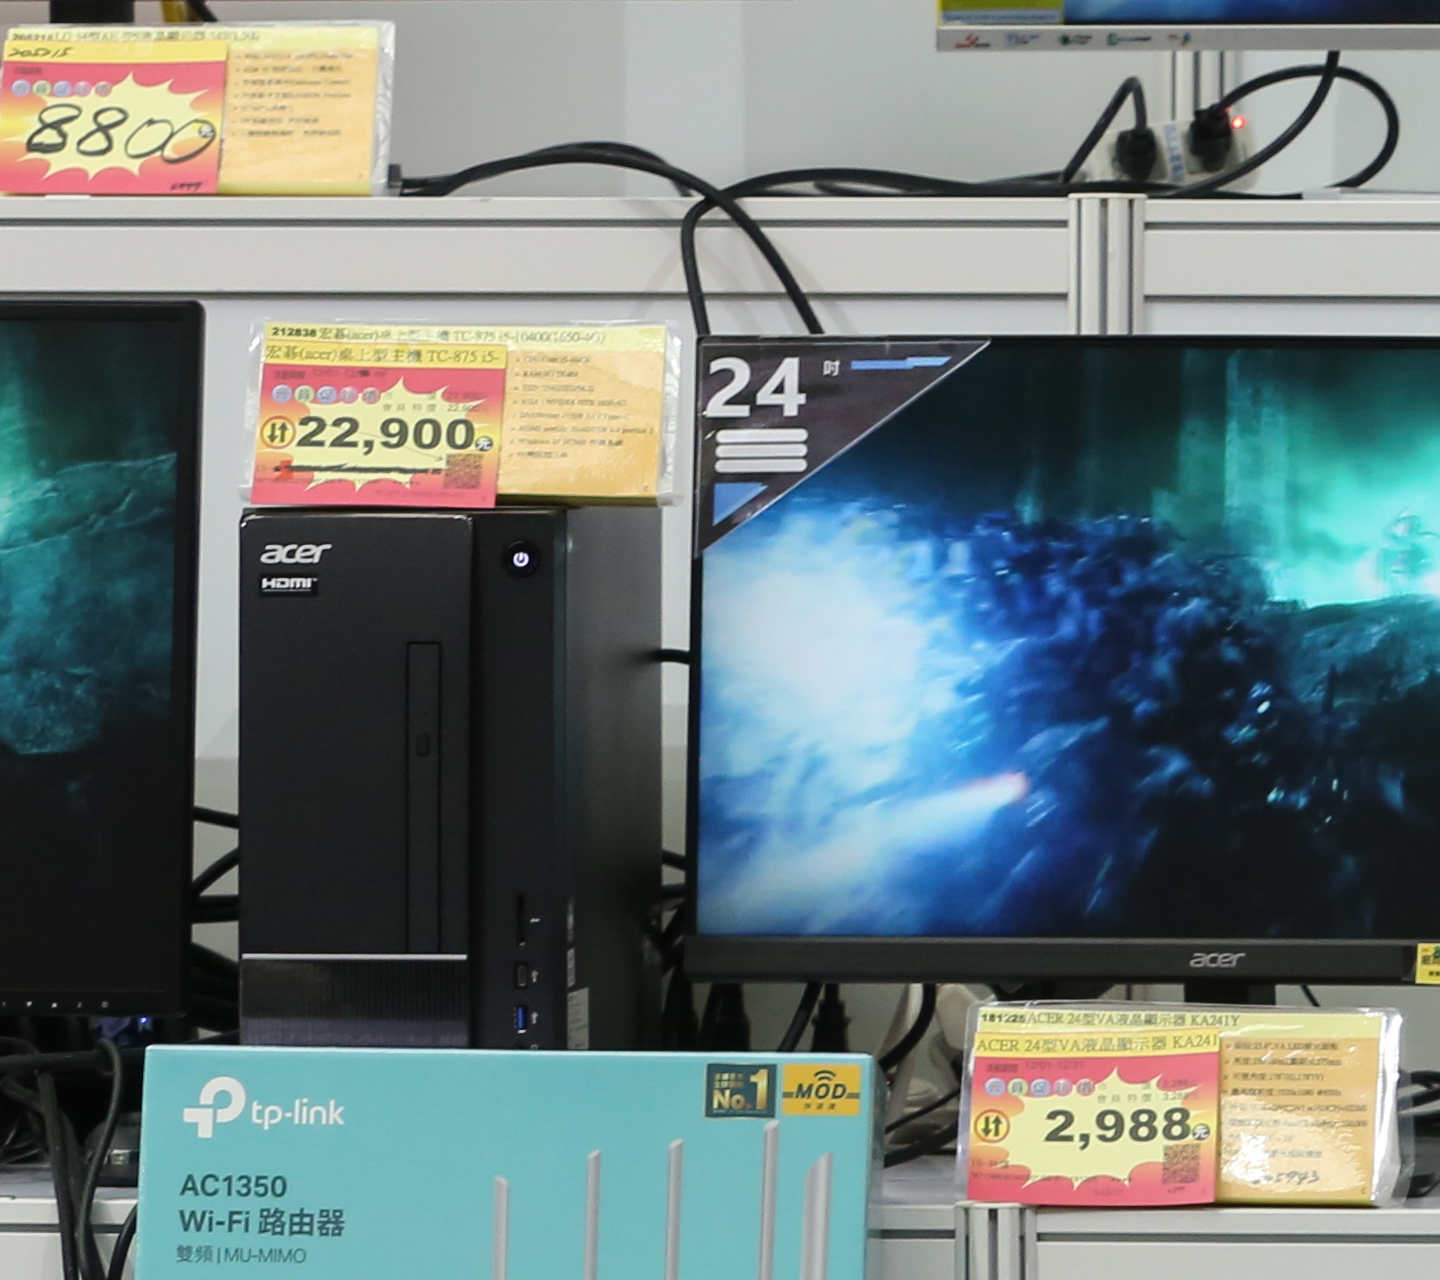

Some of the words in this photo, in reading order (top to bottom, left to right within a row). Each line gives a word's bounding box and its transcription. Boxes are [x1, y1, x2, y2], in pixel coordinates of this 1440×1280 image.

[427, 349, 478, 364] TC-875
[704, 355, 808, 419] 24
[295, 415, 477, 457] 22,900
[475, 435, 494, 452] 元
[259, 543, 333, 565] acer
[261, 577, 314, 590] HDMI
[1189, 950, 1246, 968] acer
[1026, 1012, 1066, 1025] ACER
[1189, 1013, 1241, 1028] KA241Y
[976, 1037, 1020, 1053] ACER
[1171, 1033, 1219, 1049] KA241
[794, 1083, 847, 1100] MOD
[251, 1097, 346, 1131] tp-link
[1043, 1106, 1190, 1150] 2,988
[178, 1172, 288, 1198] AC1350
[178, 1209, 251, 1234] Wi-Fi
[257, 1207, 346, 1238] 路由器
[175, 1244, 213, 1264] 雙頻
[223, 1247, 308, 1264] MU-MIMO
